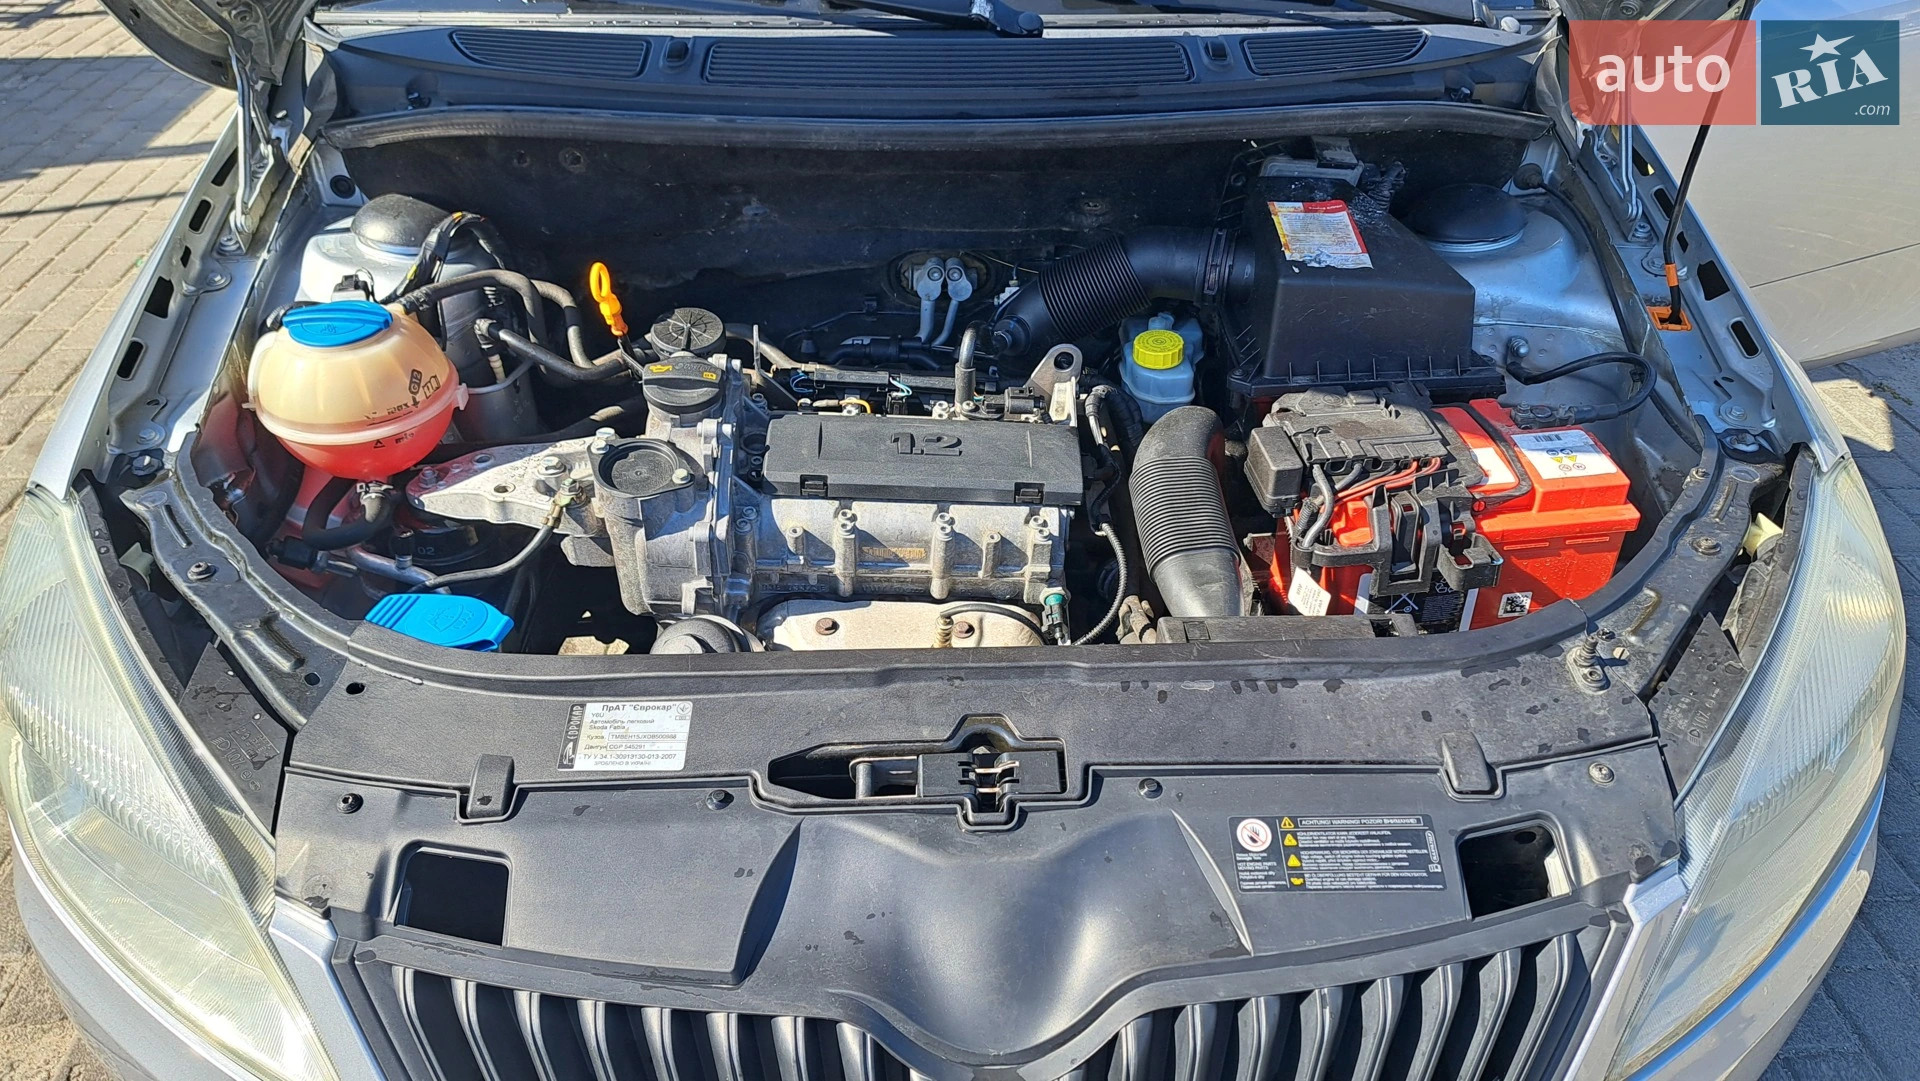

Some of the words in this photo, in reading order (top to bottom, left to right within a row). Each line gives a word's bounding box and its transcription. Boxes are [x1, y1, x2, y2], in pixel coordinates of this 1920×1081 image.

[891, 432, 963, 456] 1.2
[602, 704, 627, 713] ПрАТ
[629, 703, 677, 713] "Єврокар"
